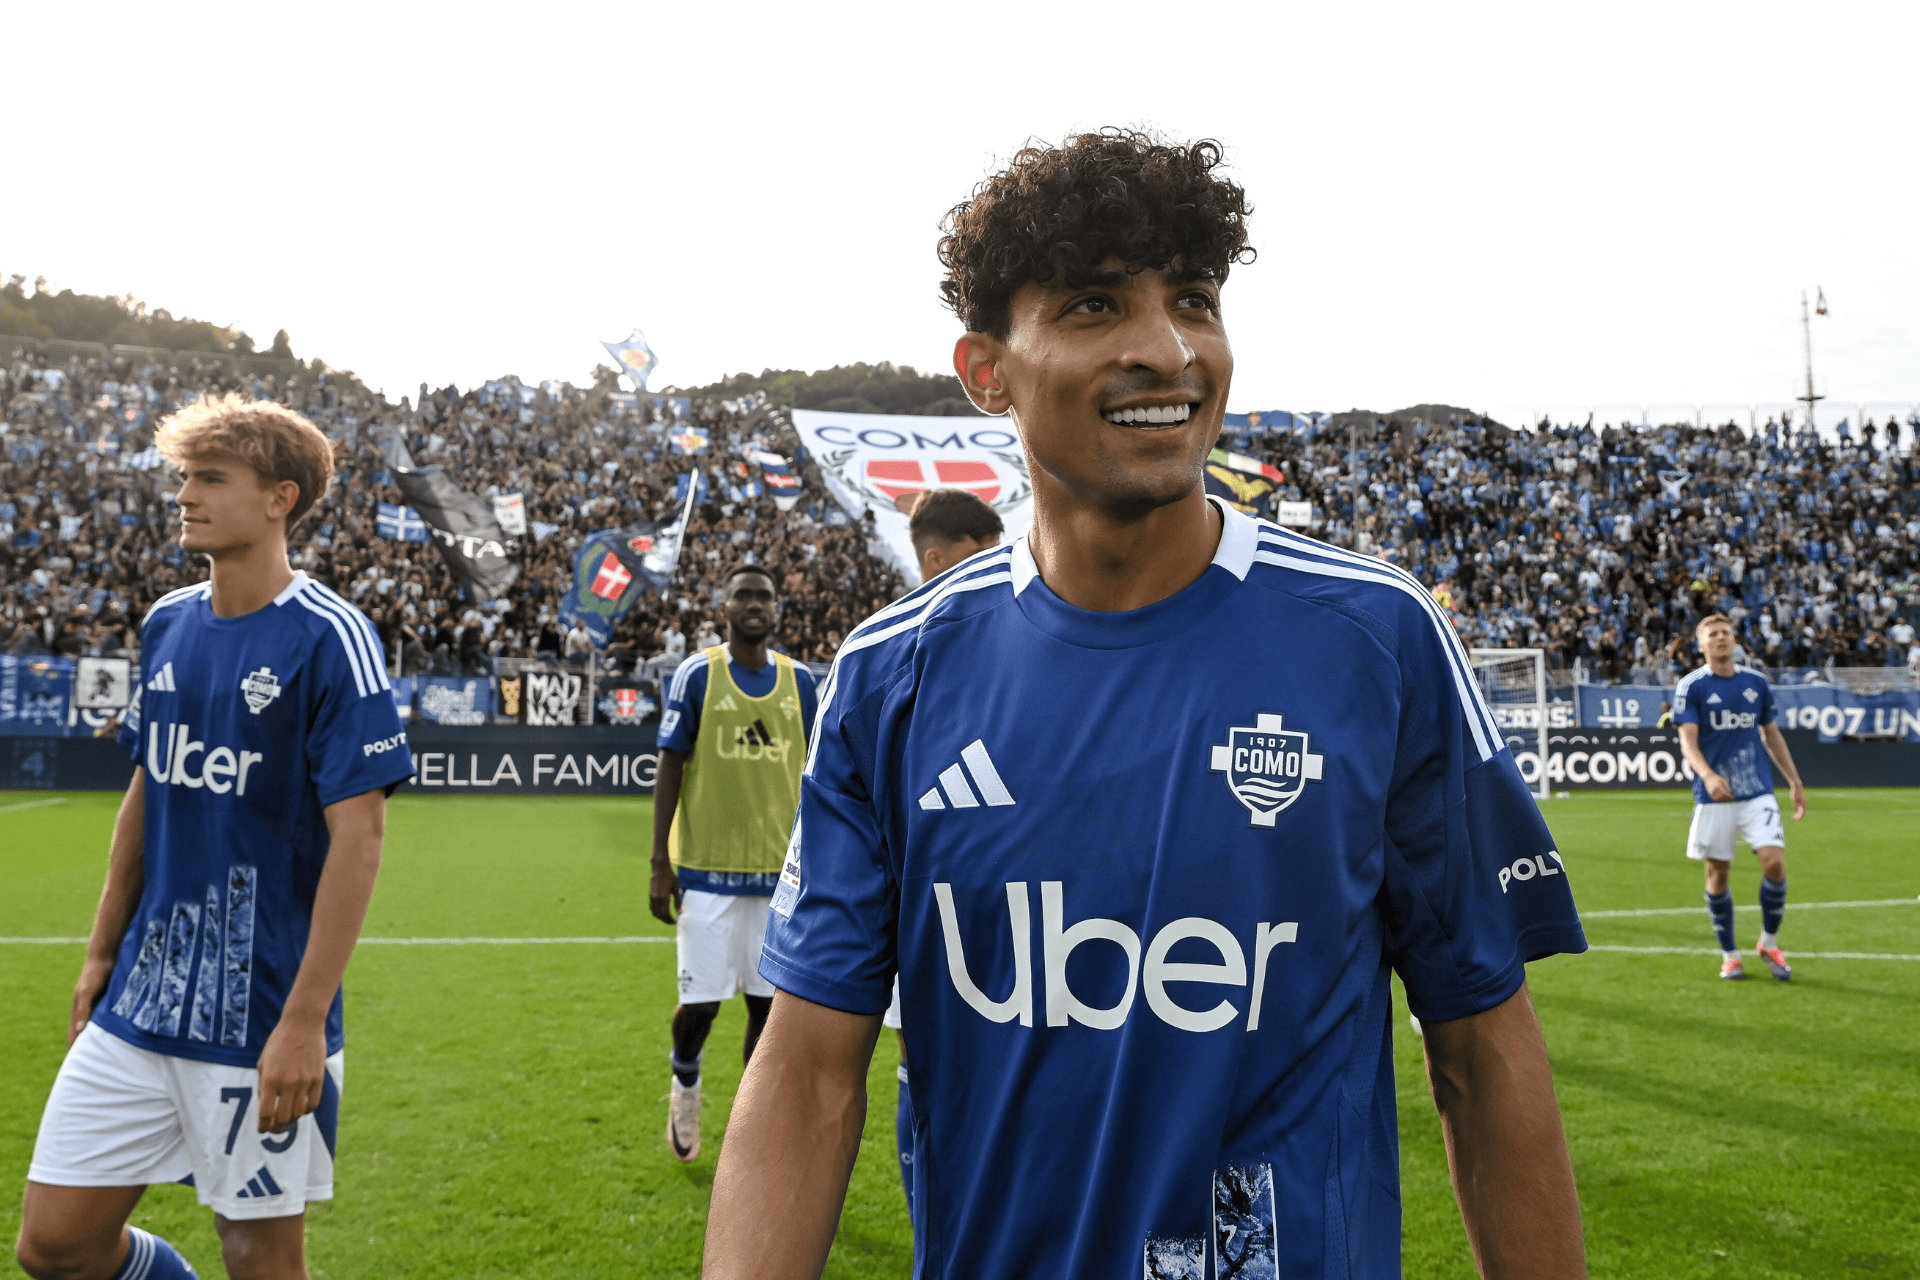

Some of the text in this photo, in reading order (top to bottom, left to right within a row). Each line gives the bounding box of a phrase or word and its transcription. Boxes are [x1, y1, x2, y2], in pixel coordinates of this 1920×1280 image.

[815, 426, 1017, 449] COMO
[1709, 709, 1757, 730] Uber
[1785, 705, 1867, 737] 1907
[363, 732, 406, 757] POLYT
[716, 725, 793, 763] Uber
[1249, 736, 1287, 748] 1907
[147, 721, 263, 796] Uber
[1235, 747, 1300, 778] COMO
[933, 881, 1299, 1032] Uber
